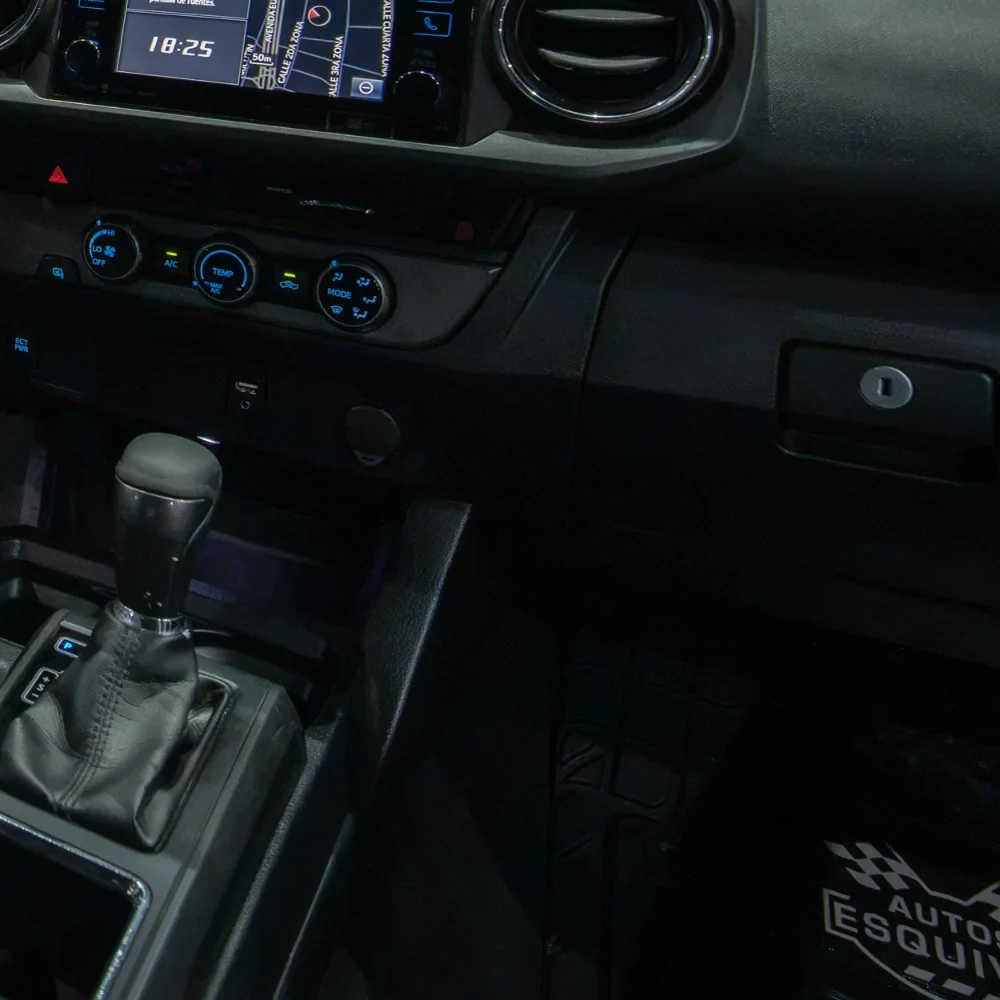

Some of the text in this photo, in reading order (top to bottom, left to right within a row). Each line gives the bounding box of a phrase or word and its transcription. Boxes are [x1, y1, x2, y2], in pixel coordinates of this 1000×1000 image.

[264, 10, 276, 43] AVENIDA
[382, 20, 392, 52] CUARTA
[149, 36, 215, 58] 18:25
[277, 21, 304, 84] CALLE 2DA ZONA
[252, 53, 272, 62] 50m
[328, 36, 344, 98] ALLE 3RA ZONA
[107, 229, 116, 237] HI
[92, 245, 102, 253] LO
[92, 257, 106, 267] OFF
[163, 259, 179, 269] A/C
[212, 267, 234, 278] TEMP
[327, 288, 352, 300] MODE
[15, 337, 28, 345] ECT
[63, 641, 72, 649] P
[888, 894, 1000, 950] AUTO
